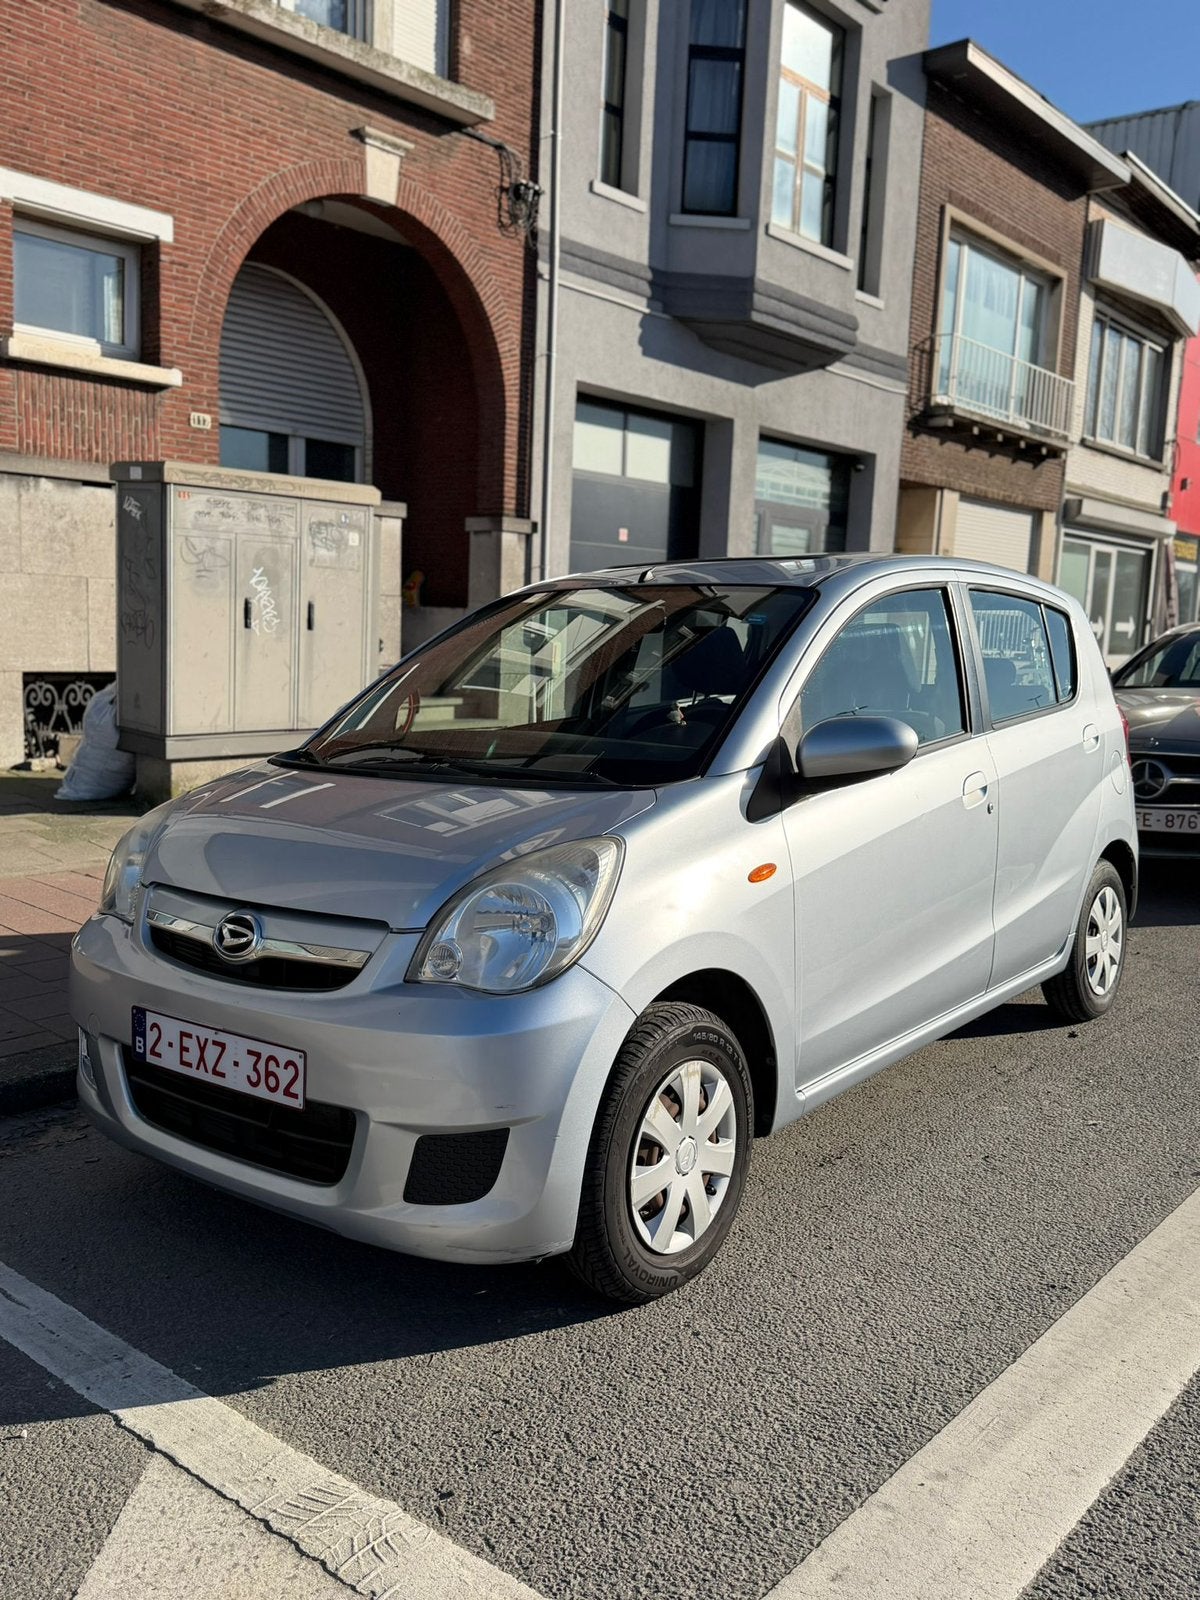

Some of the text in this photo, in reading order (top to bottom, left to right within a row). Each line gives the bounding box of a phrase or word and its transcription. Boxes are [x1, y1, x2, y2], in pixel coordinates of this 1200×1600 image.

[135, 1036, 144, 1053] B
[149, 1022, 299, 1100] 2-EXZ-362
[623, 1246, 678, 1288] UNIROYAL
